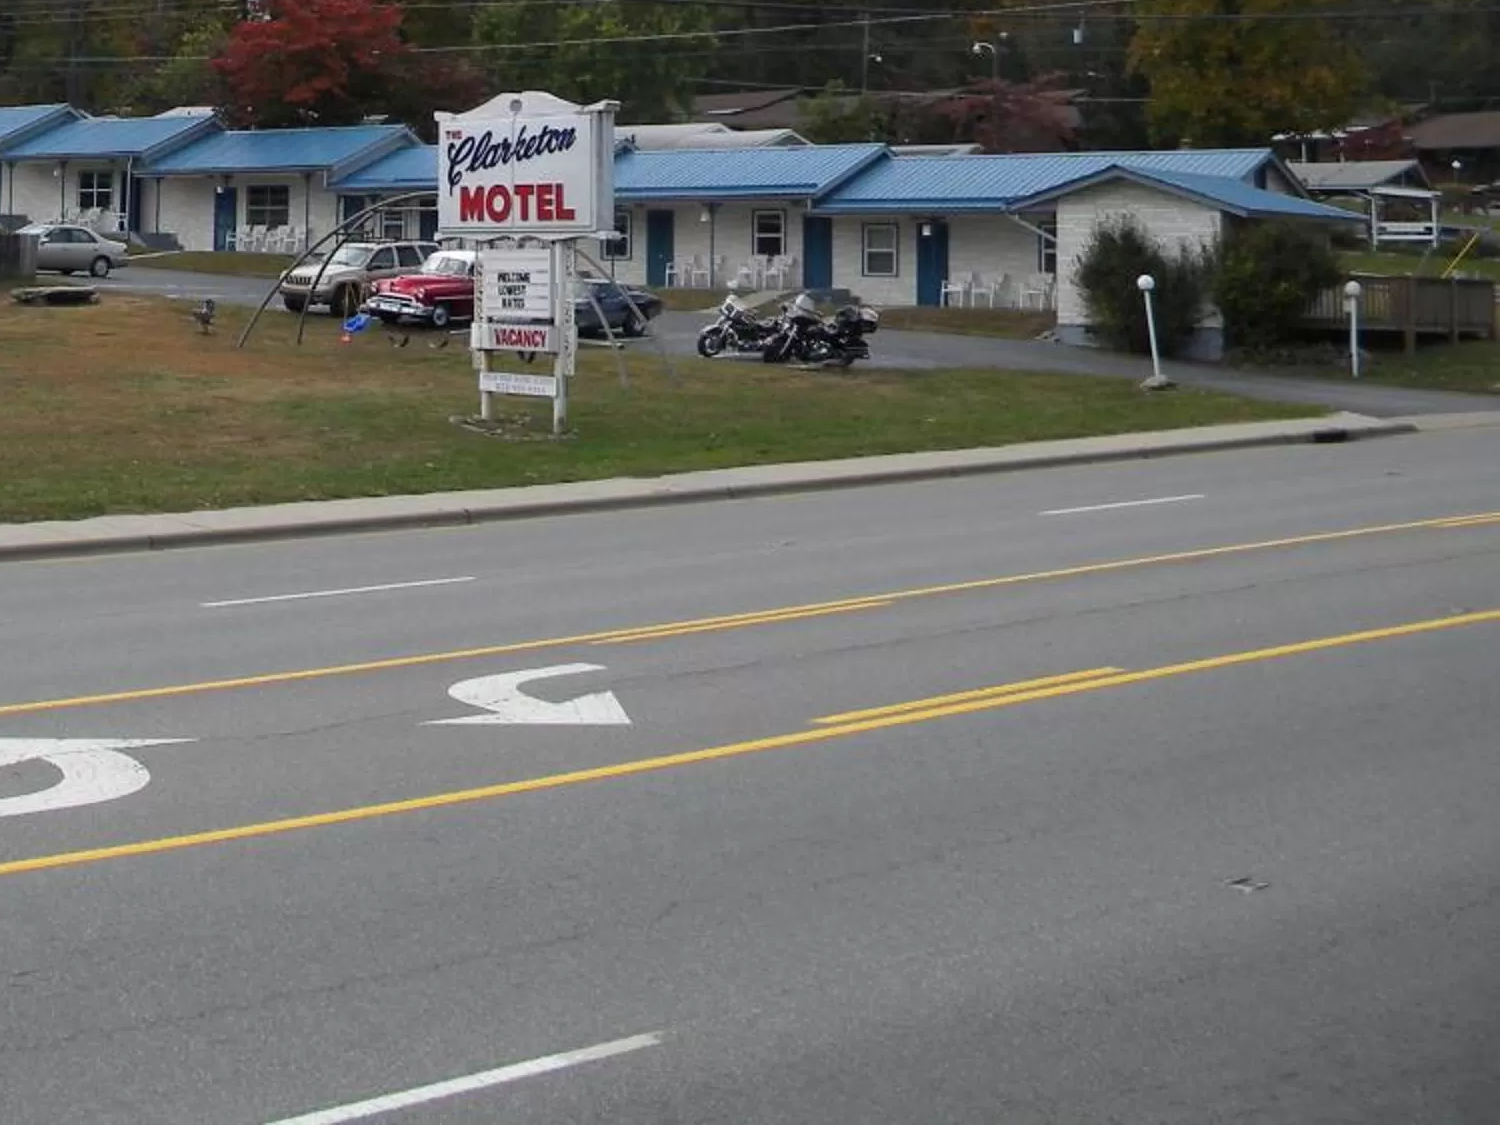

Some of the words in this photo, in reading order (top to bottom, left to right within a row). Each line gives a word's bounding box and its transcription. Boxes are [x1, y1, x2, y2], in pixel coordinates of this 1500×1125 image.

[445, 130, 463, 140] THE
[447, 124, 576, 197] Clarketon
[460, 183, 576, 224] MOTEL
[494, 327, 546, 348] VACANCY
